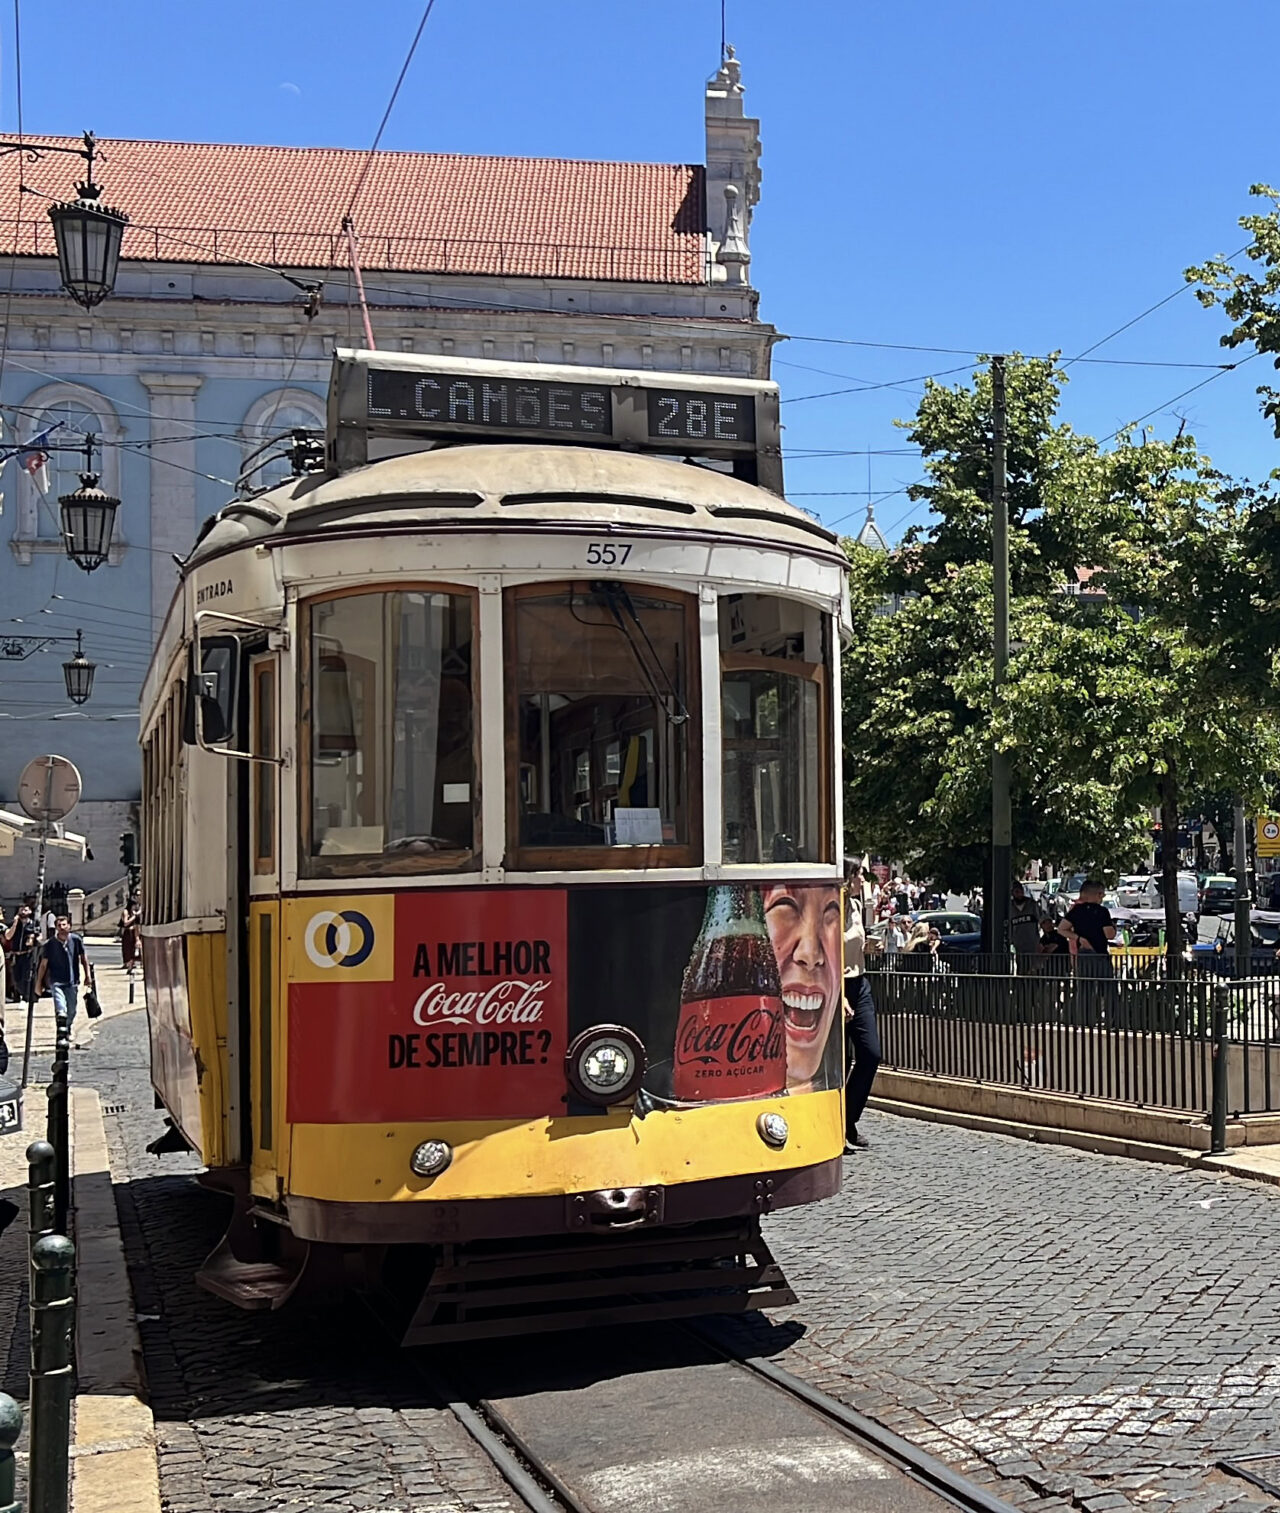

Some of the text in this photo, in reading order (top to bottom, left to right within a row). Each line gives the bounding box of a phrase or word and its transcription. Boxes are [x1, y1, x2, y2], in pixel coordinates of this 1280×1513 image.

[657, 397, 738, 440] 28E
[586, 543, 632, 565] 557
[197, 579, 233, 605] ENTRADA
[413, 940, 551, 977] A MELHOR
[413, 980, 552, 1026] Coca-Cola
[389, 1029, 552, 1069] DE SEMPRE?
[677, 1009, 783, 1065] Coca-Cola
[695, 1066, 764, 1078] ZERO AÇÚCAR
